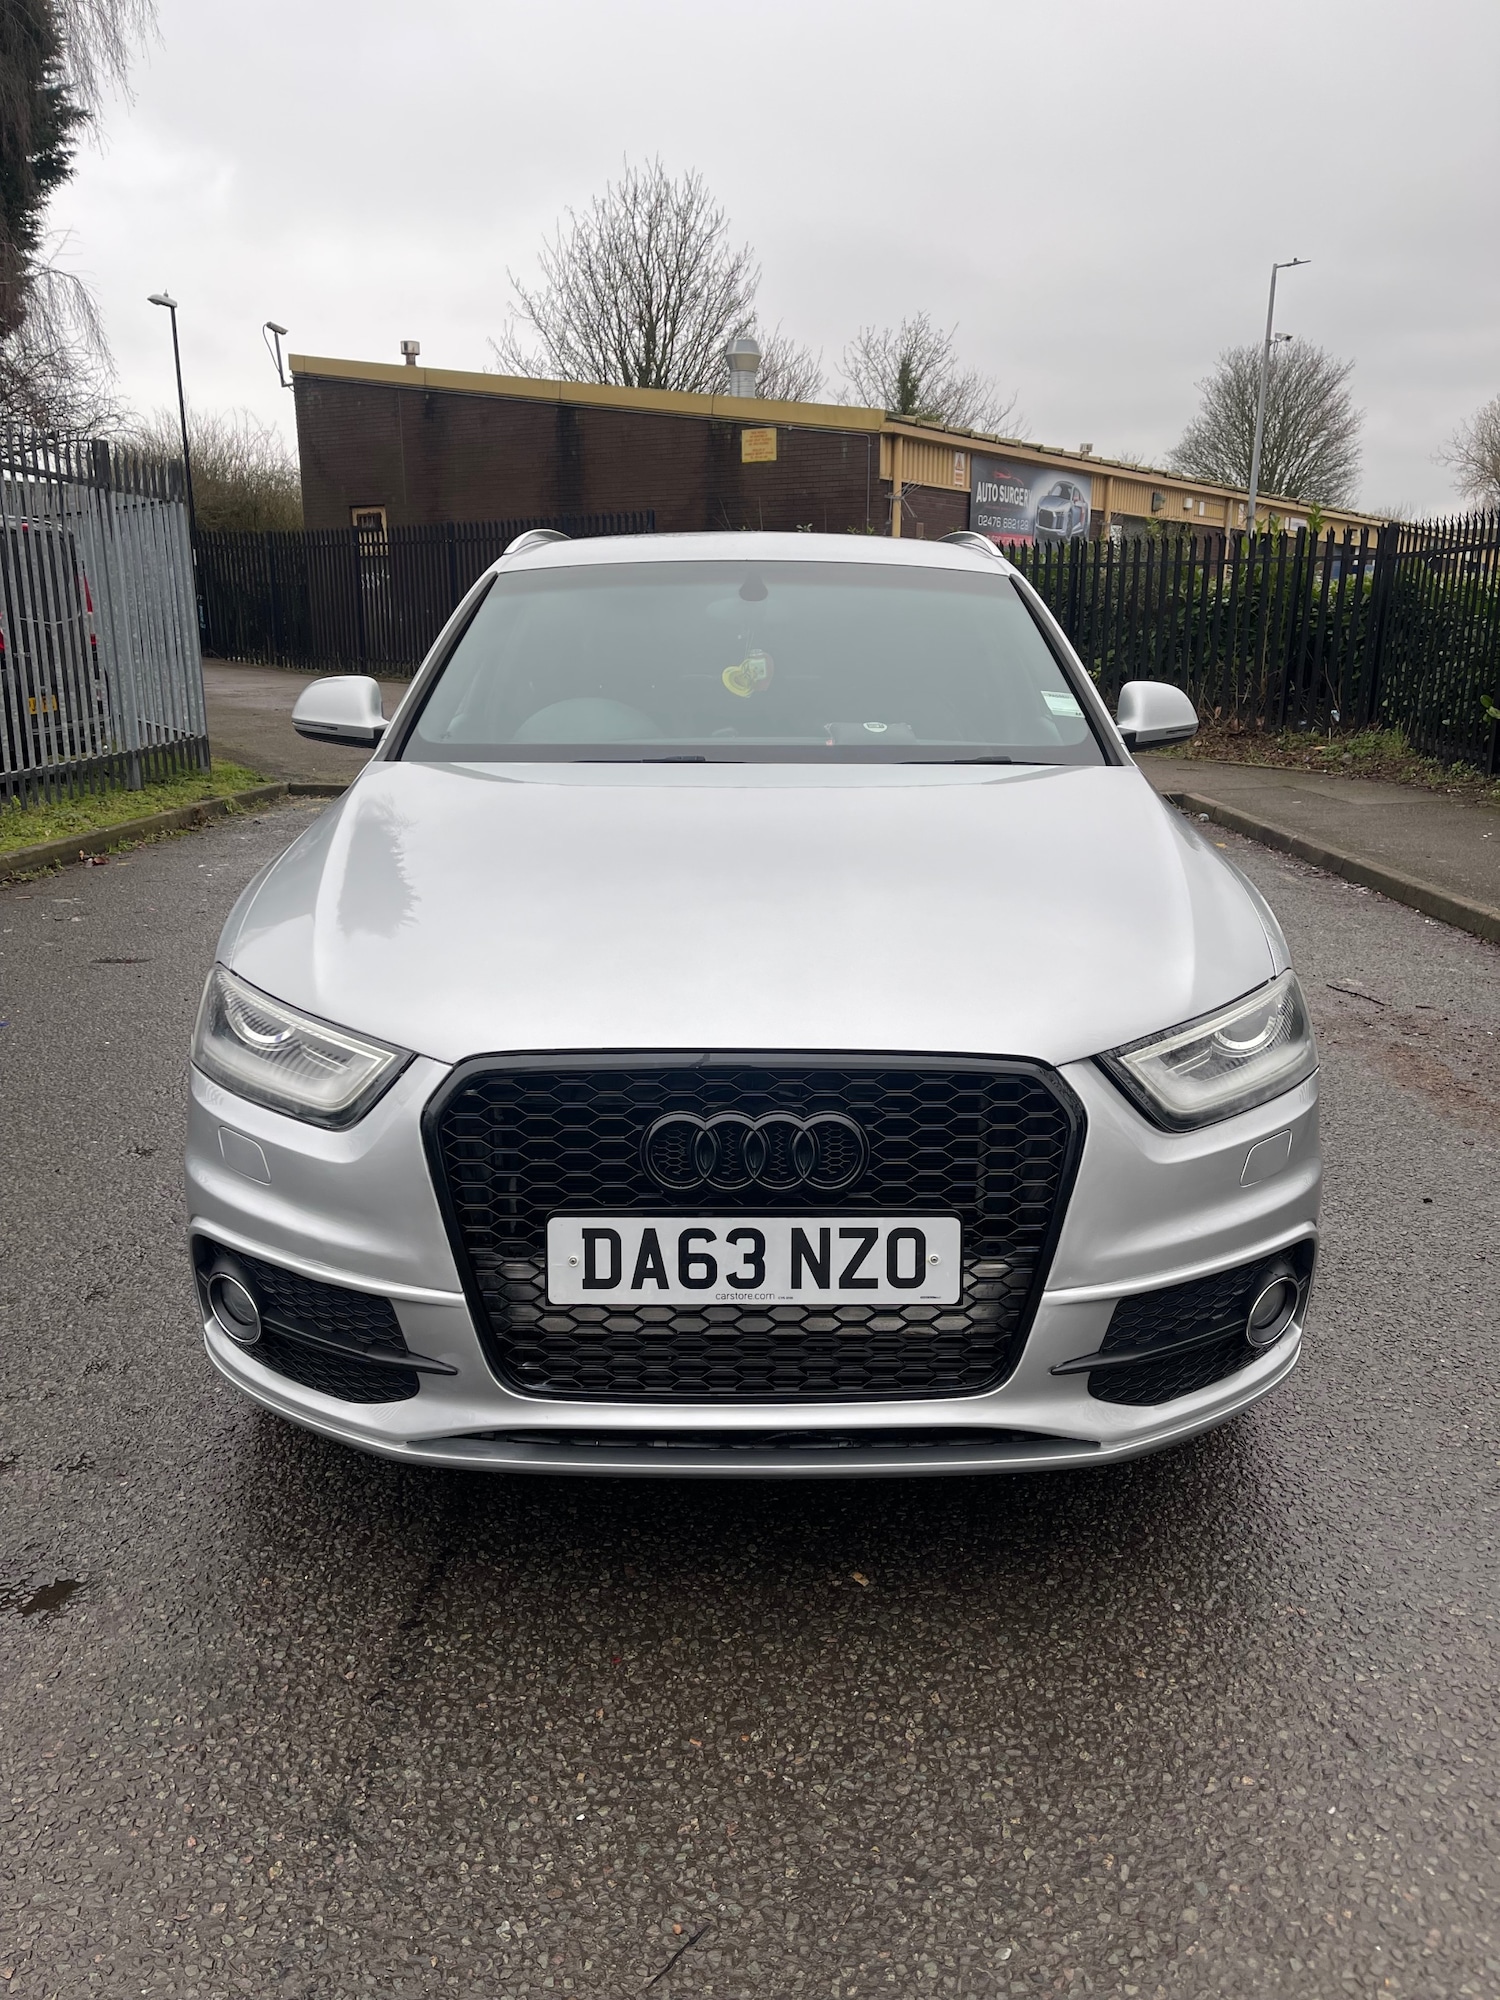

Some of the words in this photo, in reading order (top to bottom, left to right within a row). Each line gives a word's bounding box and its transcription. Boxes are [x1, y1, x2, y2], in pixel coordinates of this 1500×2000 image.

[976, 481, 998, 503] AUTO
[978, 514, 1001, 528] 02476
[582, 1228, 766, 1290] DA63
[791, 1228, 926, 1290] NZO
[715, 1292, 775, 1301] carstore.com
